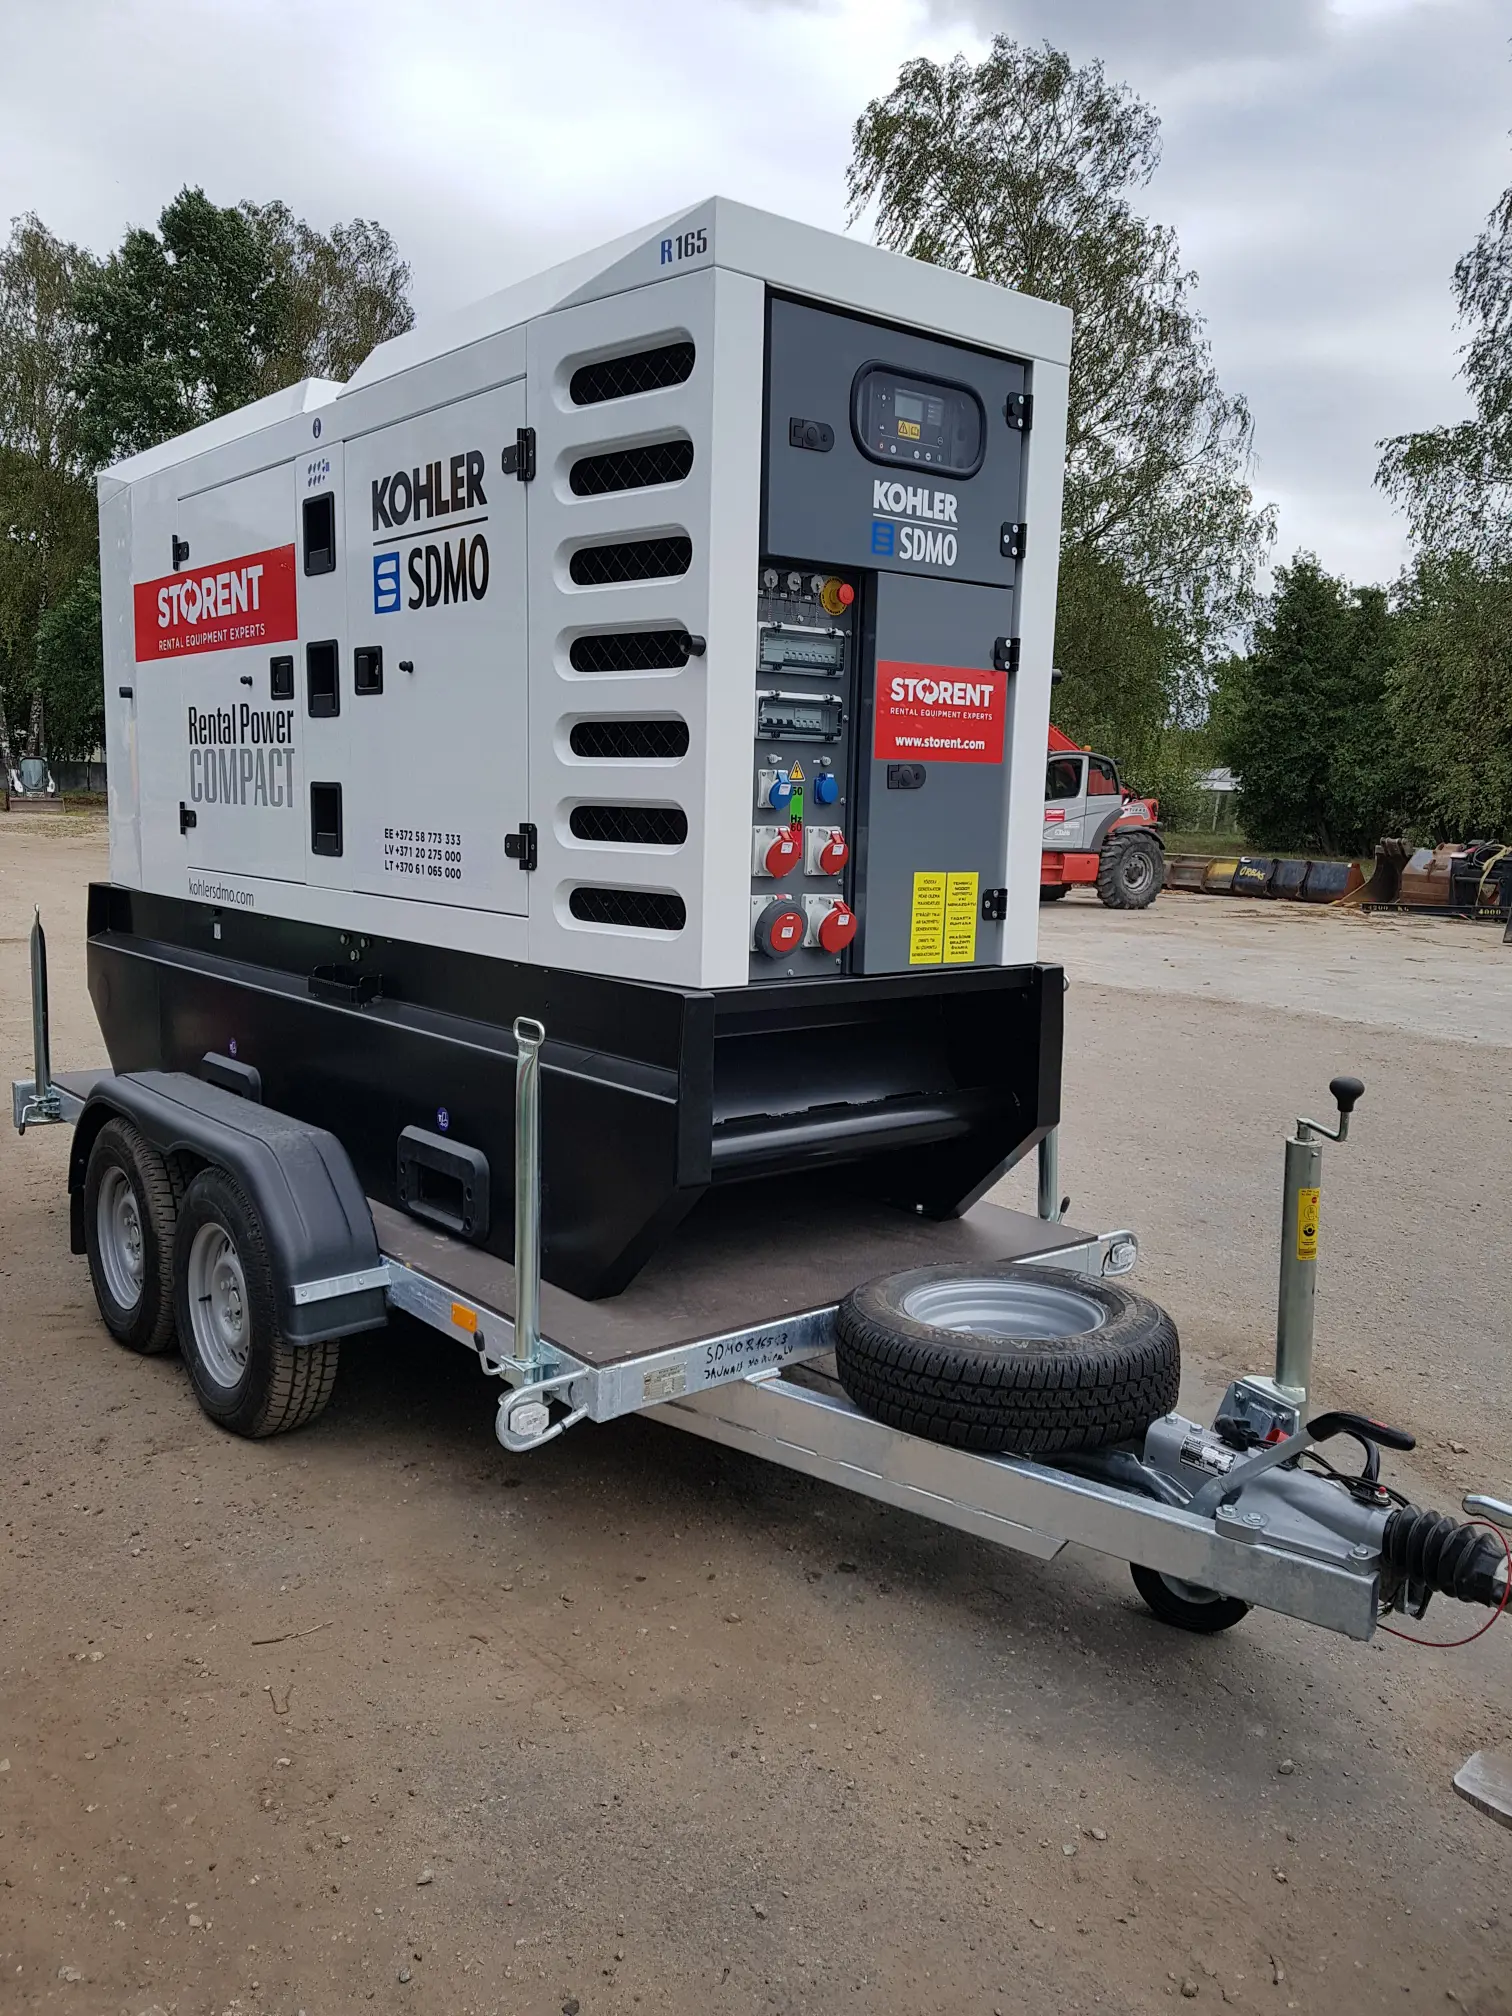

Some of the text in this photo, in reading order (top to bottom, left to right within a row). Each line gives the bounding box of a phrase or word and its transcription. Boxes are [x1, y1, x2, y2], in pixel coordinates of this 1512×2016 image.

[661, 227, 708, 265] R 165
[372, 450, 488, 532] KOHLER
[873, 479, 958, 523] KOHLER
[899, 526, 958, 567] SDMO
[408, 533, 490, 610] SDMO
[157, 564, 264, 628] STORENT
[158, 623, 266, 651] RENTAL EQUIPMENT EXPERTS
[890, 677, 994, 707] STORENT
[188, 703, 294, 745] Rental Power
[890, 707, 993, 721] RENTAL EQUIPMENT EXPERTS
[895, 736, 985, 750] www.storent.com
[190, 747, 295, 808] COMPACT
[384, 828, 461, 846] EE +372 58 773 333
[384, 844, 461, 863] LV +371 20 275 000
[384, 859, 461, 880] LT +370 61 065 000
[188, 877, 255, 907] kohlersdmo.com
[706, 1342, 743, 1364] SDMO
